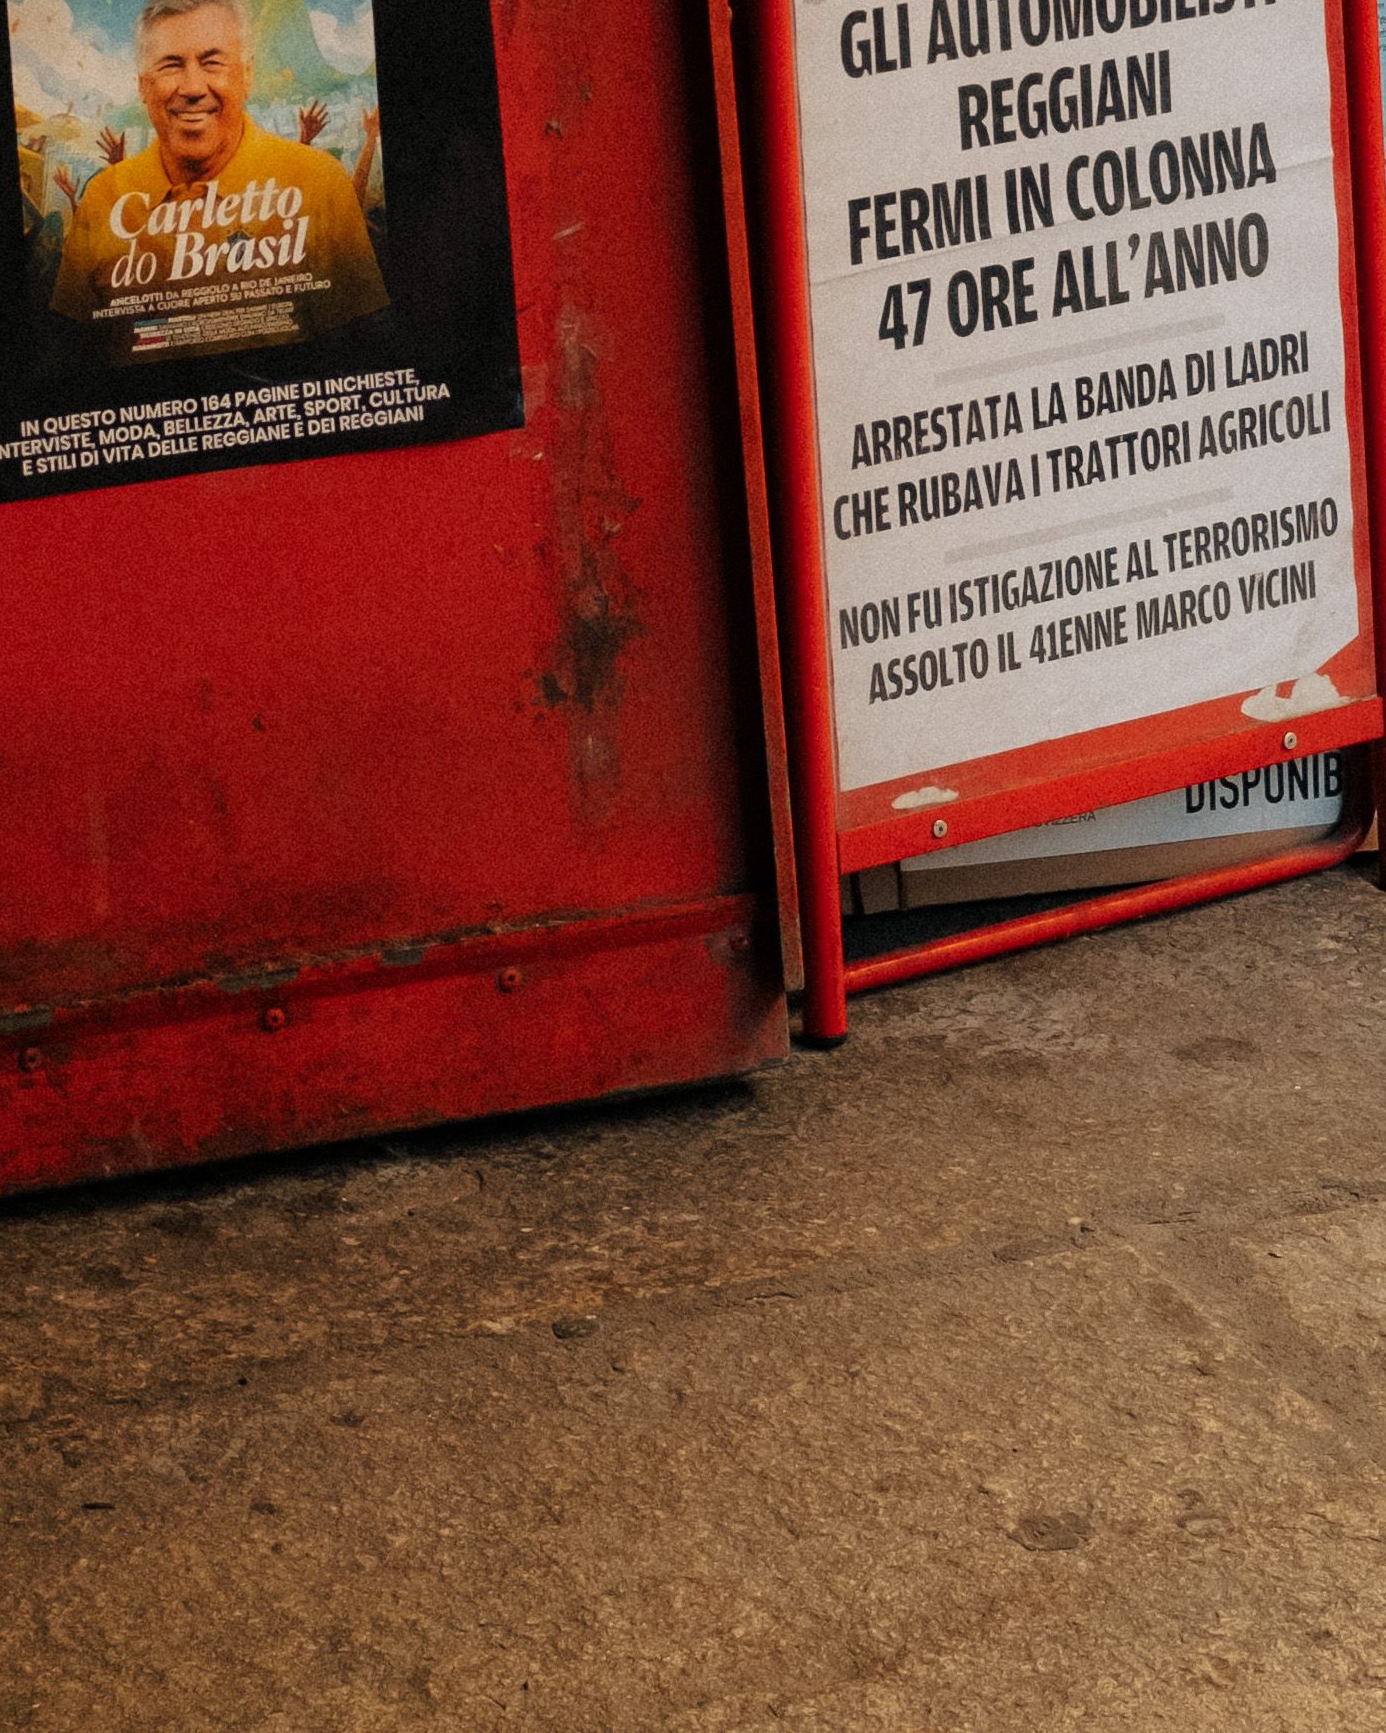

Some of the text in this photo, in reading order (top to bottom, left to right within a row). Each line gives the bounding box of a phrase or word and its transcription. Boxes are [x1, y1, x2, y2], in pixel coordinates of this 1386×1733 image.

[840, 6, 912, 79] GLI
[959, 51, 1173, 150] REGGIANI
[110, 178, 302, 239] Carletto
[111, 216, 310, 288] do Brasil
[848, 122, 1277, 266] FERMI IN COLONNA
[878, 212, 1270, 353] 47 ORE ALL'ANNO
[20, 368, 420, 437] IN QUESTO NUMERO 164 PAGINE DI INCHIESTE,
[99, 384, 450, 447] MODA, BELLEZZA, ARTE, SPORT, CULTURA
[851, 332, 1309, 470] ARRESTATA LA BANDA DI LADRI
[834, 390, 1332, 539] CHE RUBAVA I TRATTORI AGRICOLI
[839, 497, 1339, 650] NON FU ISTIGAZIONE AL TERRORISMO
[867, 562, 1317, 706] ASSOLTO IL 41ENNE MARCO VICINI
